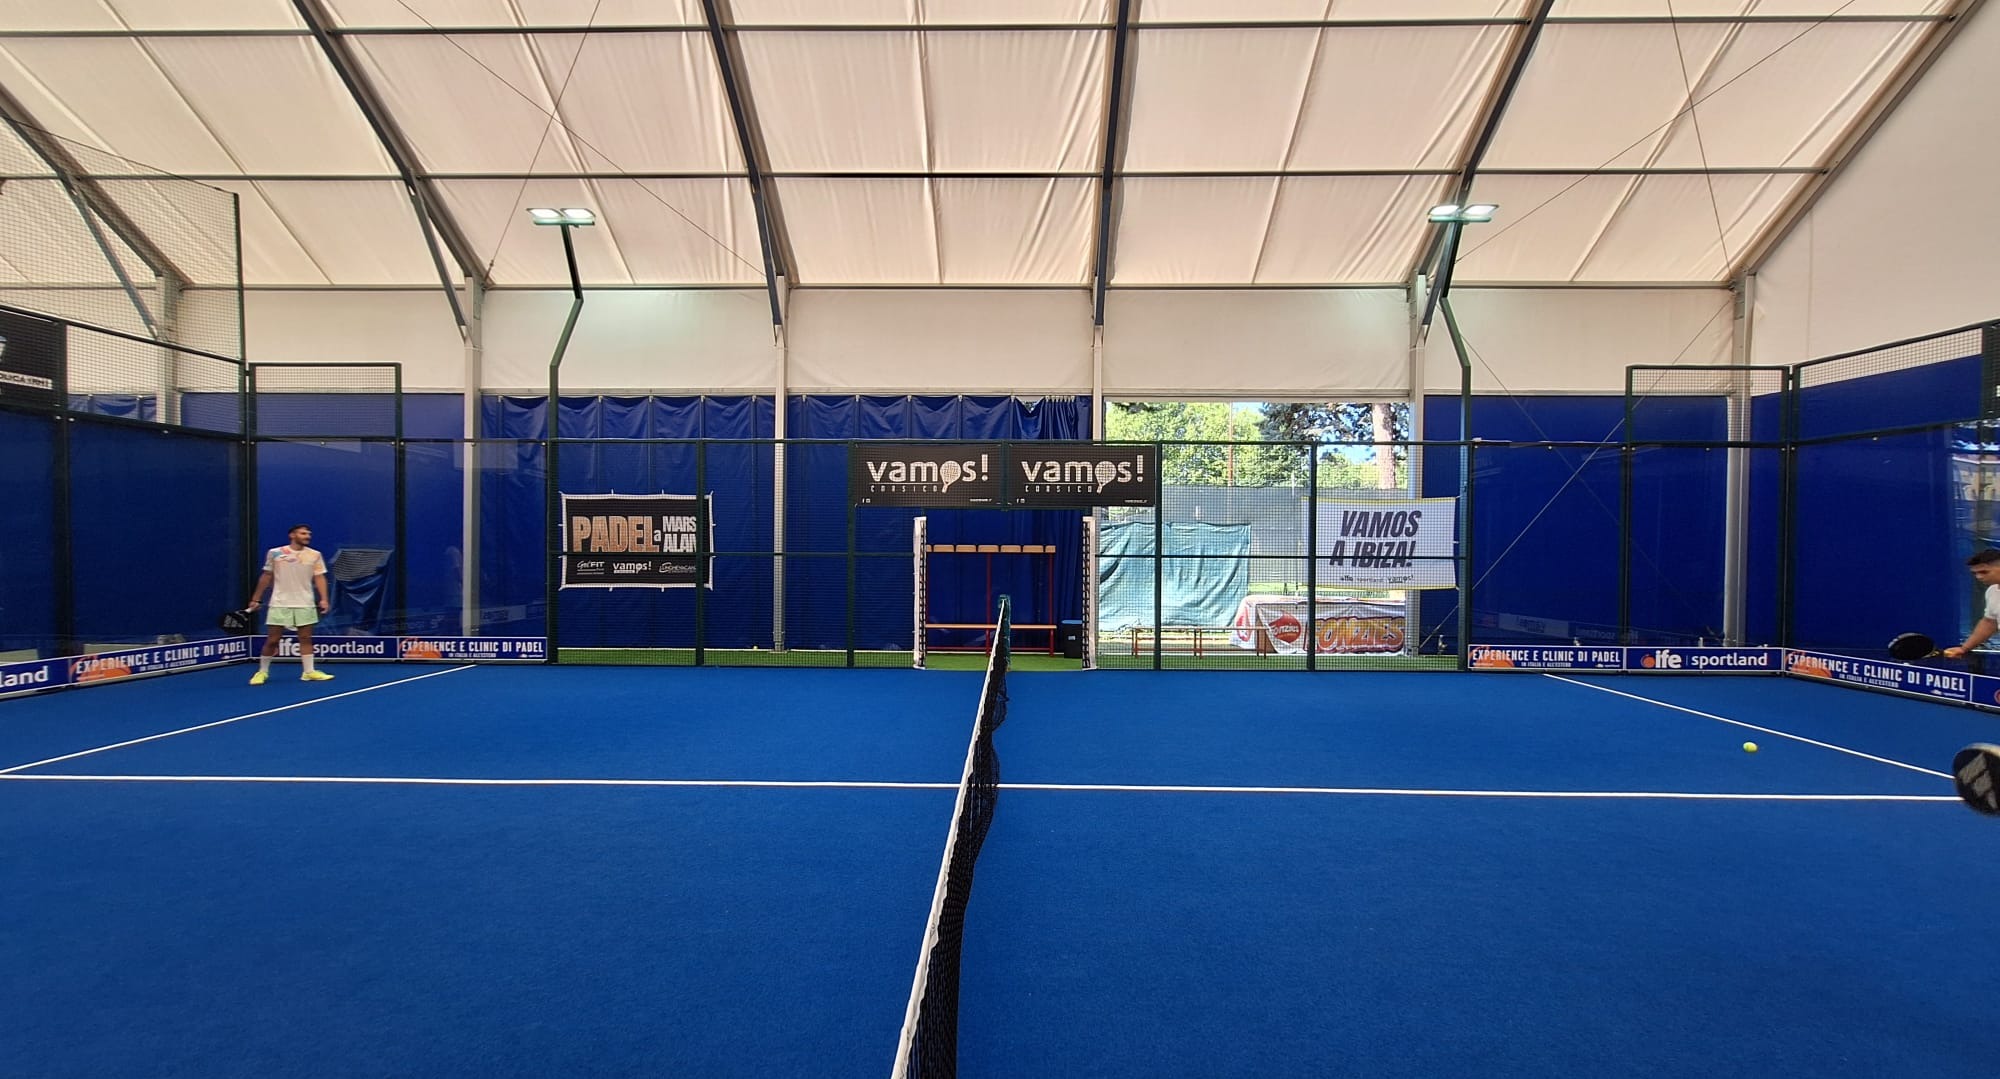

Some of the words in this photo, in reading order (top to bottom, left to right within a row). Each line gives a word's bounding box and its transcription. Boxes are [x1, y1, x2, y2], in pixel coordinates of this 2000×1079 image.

[866, 454, 988, 490] vamos!
[1021, 454, 1144, 490] vamos!
[870, 485, 938, 493] CORSICO
[1025, 485, 1092, 493] CORSICO
[572, 516, 660, 552] PADEL
[653, 529, 662, 542] a
[662, 516, 697, 532] MARS
[1340, 510, 1422, 538] VAMOS
[1329, 540, 1346, 566] A
[1351, 541, 1416, 568] IBIZA!
[612, 561, 652, 573] vamos!
[76, 653, 149, 674] EXPERIENCE
[154, 652, 161, 663] E
[164, 646, 200, 662] CLINIC
[203, 643, 215, 656] DI
[218, 640, 247, 654] PADEL
[312, 641, 385, 657] sportland
[402, 641, 458, 652] EXPERIENCE
[459, 641, 465, 652] E
[468, 641, 499, 653] CLINIC
[502, 641, 512, 653] DI
[515, 641, 544, 653] PADEL
[1472, 650, 1529, 661] EXPERIENCE
[1533, 650, 1539, 661] E
[1542, 651, 1574, 662] CLINIC
[1577, 651, 1588, 662] DI
[1591, 651, 1621, 663] PADEL
[1691, 652, 1768, 669] sportland
[1788, 653, 1848, 673] EXPERIENCE
[1853, 663, 1859, 675] E
[1864, 665, 1903, 682] CLINIC
[1908, 673, 1920, 685] DI
[1926, 674, 1966, 692] PADEL
